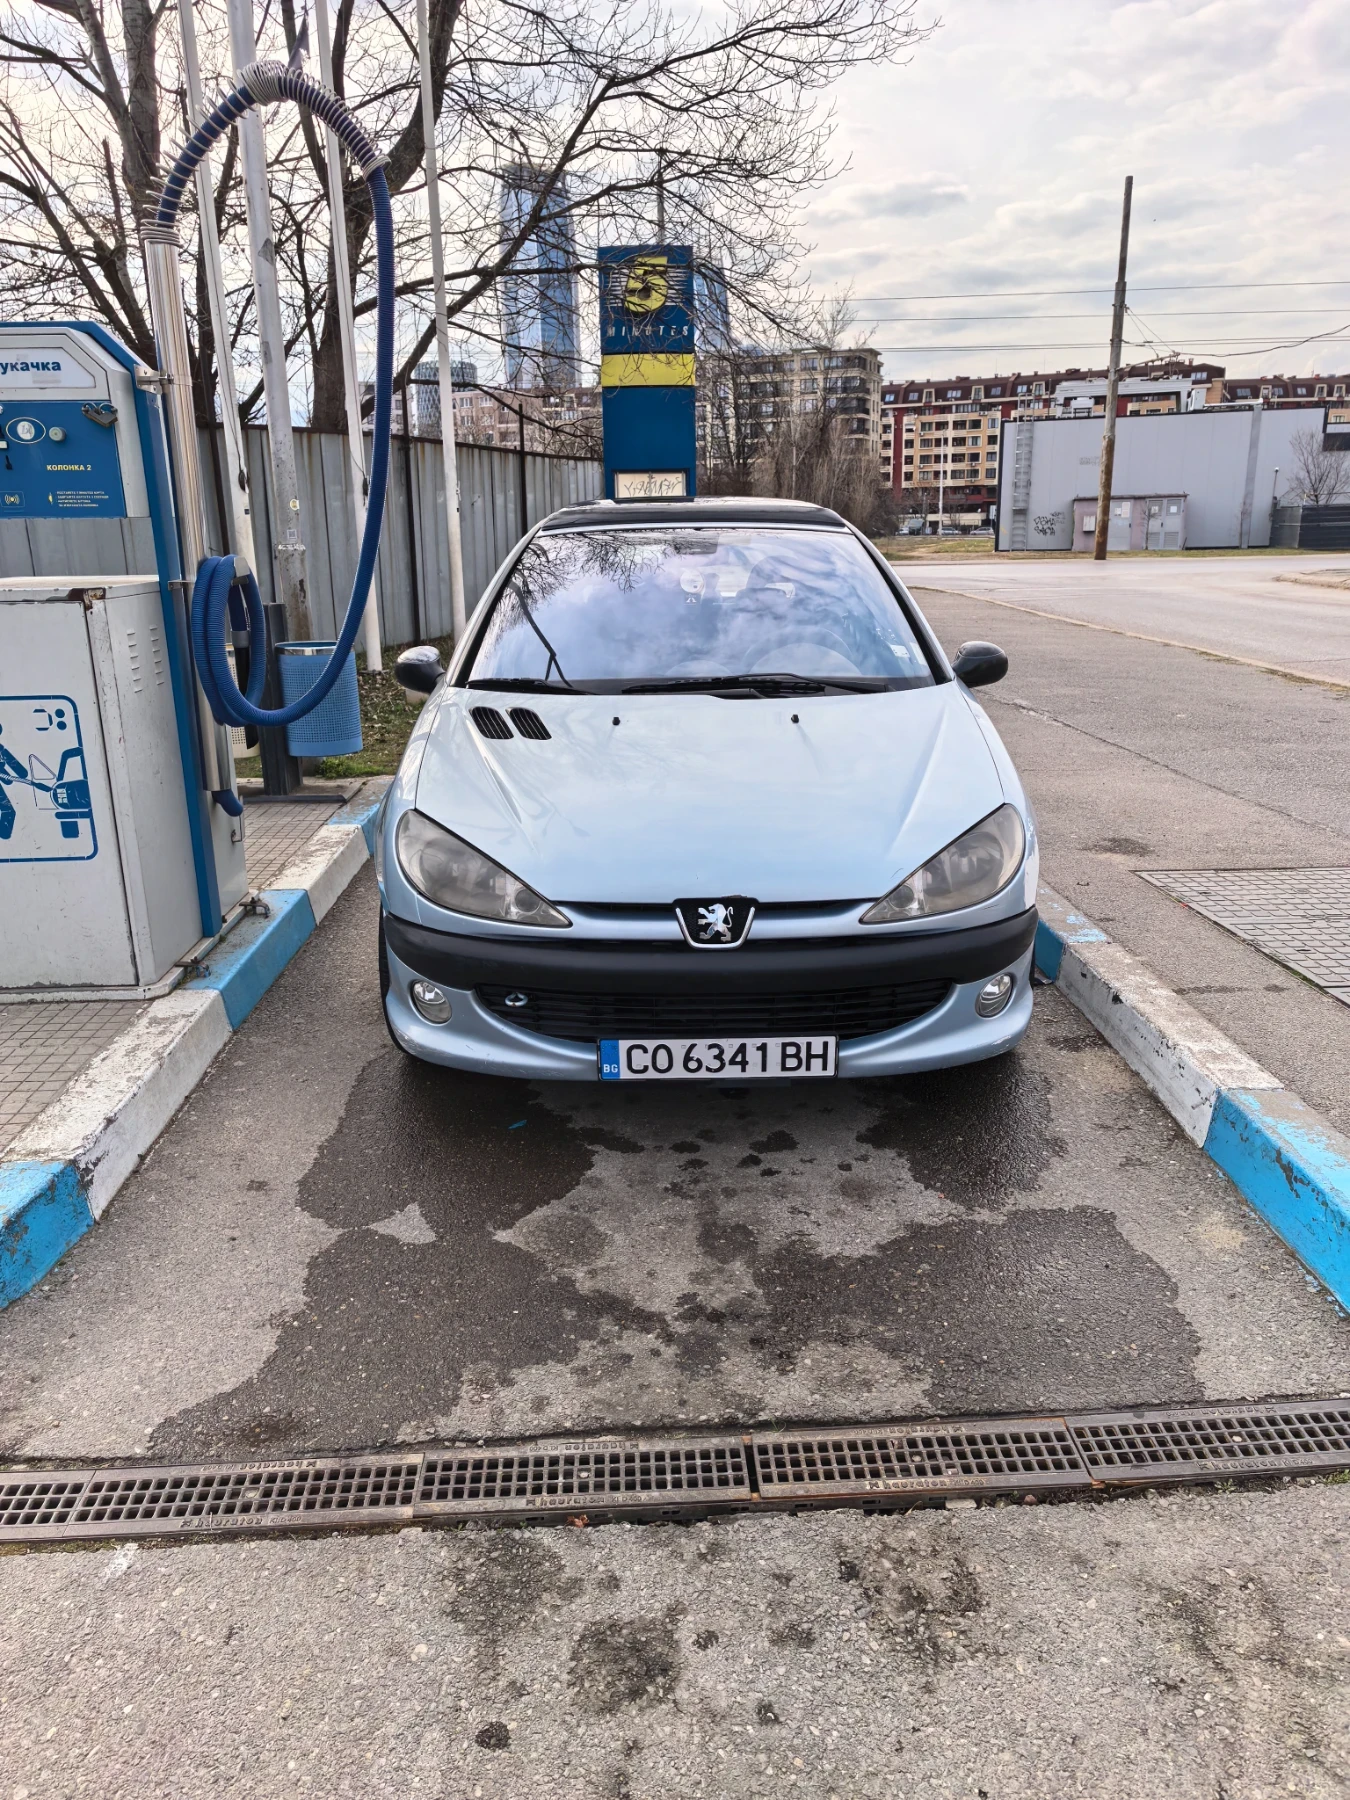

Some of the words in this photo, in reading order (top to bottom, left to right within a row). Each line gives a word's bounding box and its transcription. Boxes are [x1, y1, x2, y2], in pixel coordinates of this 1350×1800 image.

[624, 256, 669, 314] 5
[626, 1043, 674, 1074] CO
[682, 1042, 768, 1074] 6341
[780, 1041, 829, 1072] BH
[603, 1064, 619, 1073] BG
[565, 1442, 626, 1451] hauraton
[540, 1497, 605, 1507] hauraton
